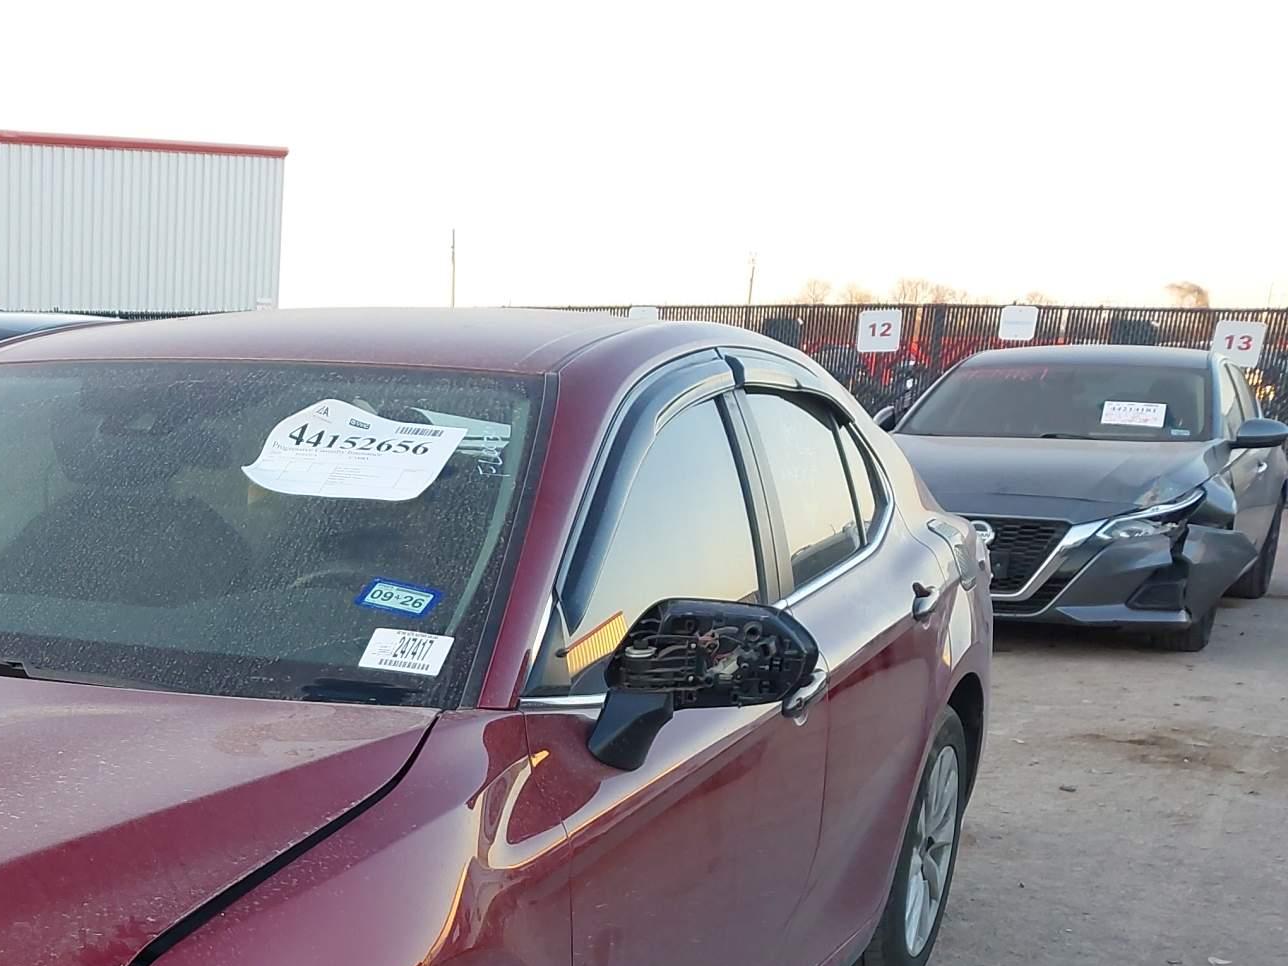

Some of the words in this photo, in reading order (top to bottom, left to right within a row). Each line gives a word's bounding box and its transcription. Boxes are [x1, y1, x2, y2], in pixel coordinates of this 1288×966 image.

[868, 322, 893, 337] 12
[1224, 334, 1253, 351] 13
[288, 423, 432, 456] 44152656
[370, 589, 394, 602] 09
[400, 595, 425, 609] 26
[392, 636, 435, 661] 247417
